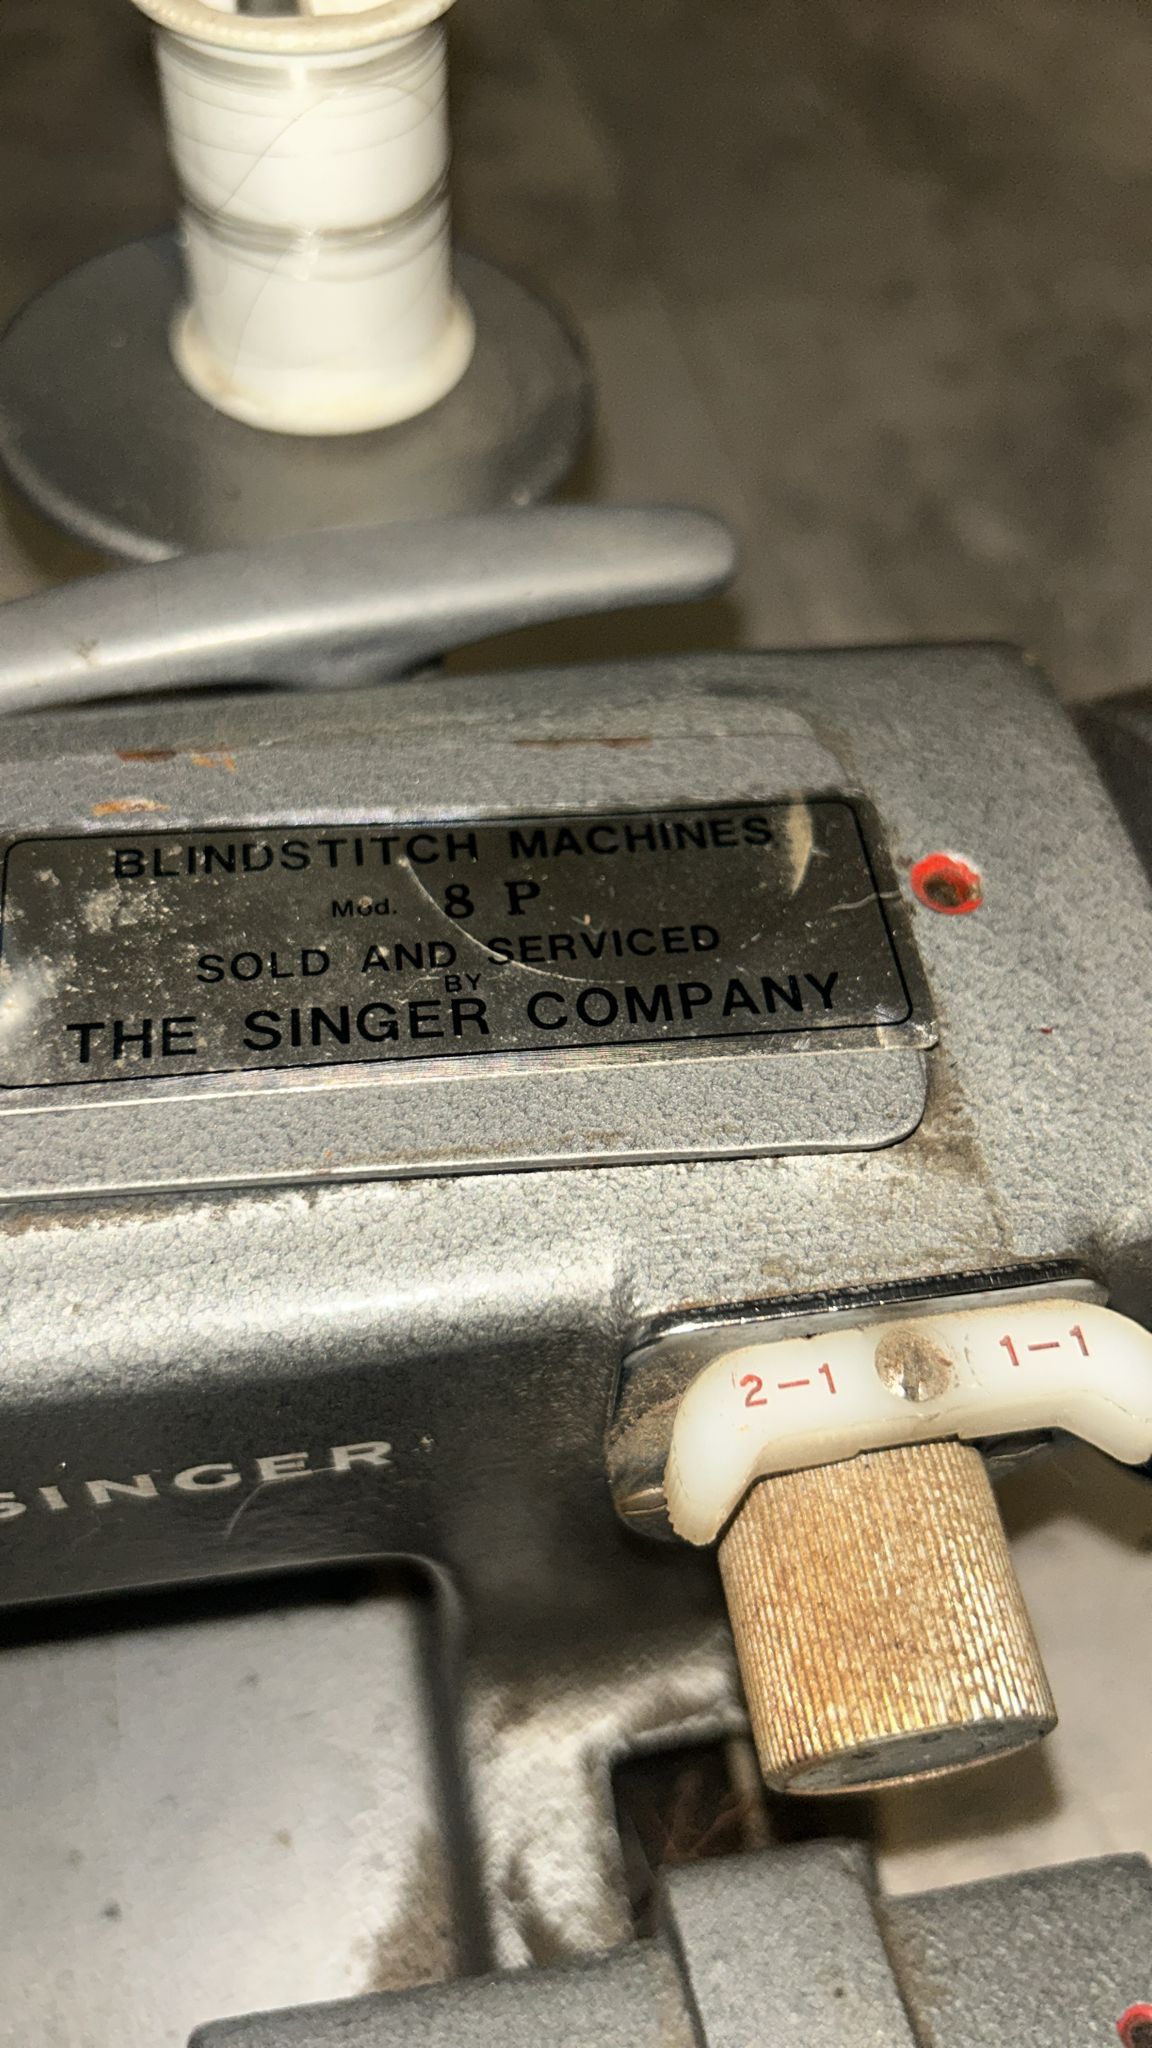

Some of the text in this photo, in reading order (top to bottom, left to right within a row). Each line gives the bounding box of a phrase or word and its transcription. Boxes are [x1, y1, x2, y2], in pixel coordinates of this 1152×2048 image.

[114, 816, 774, 880] BLINDSTITCH MACHINES
[331, 880, 541, 919] Mod. 8 P
[197, 925, 721, 984] SOLD AND SERVICED
[444, 973, 481, 993] BY
[66, 971, 839, 1063] THE SINGER COMPANY
